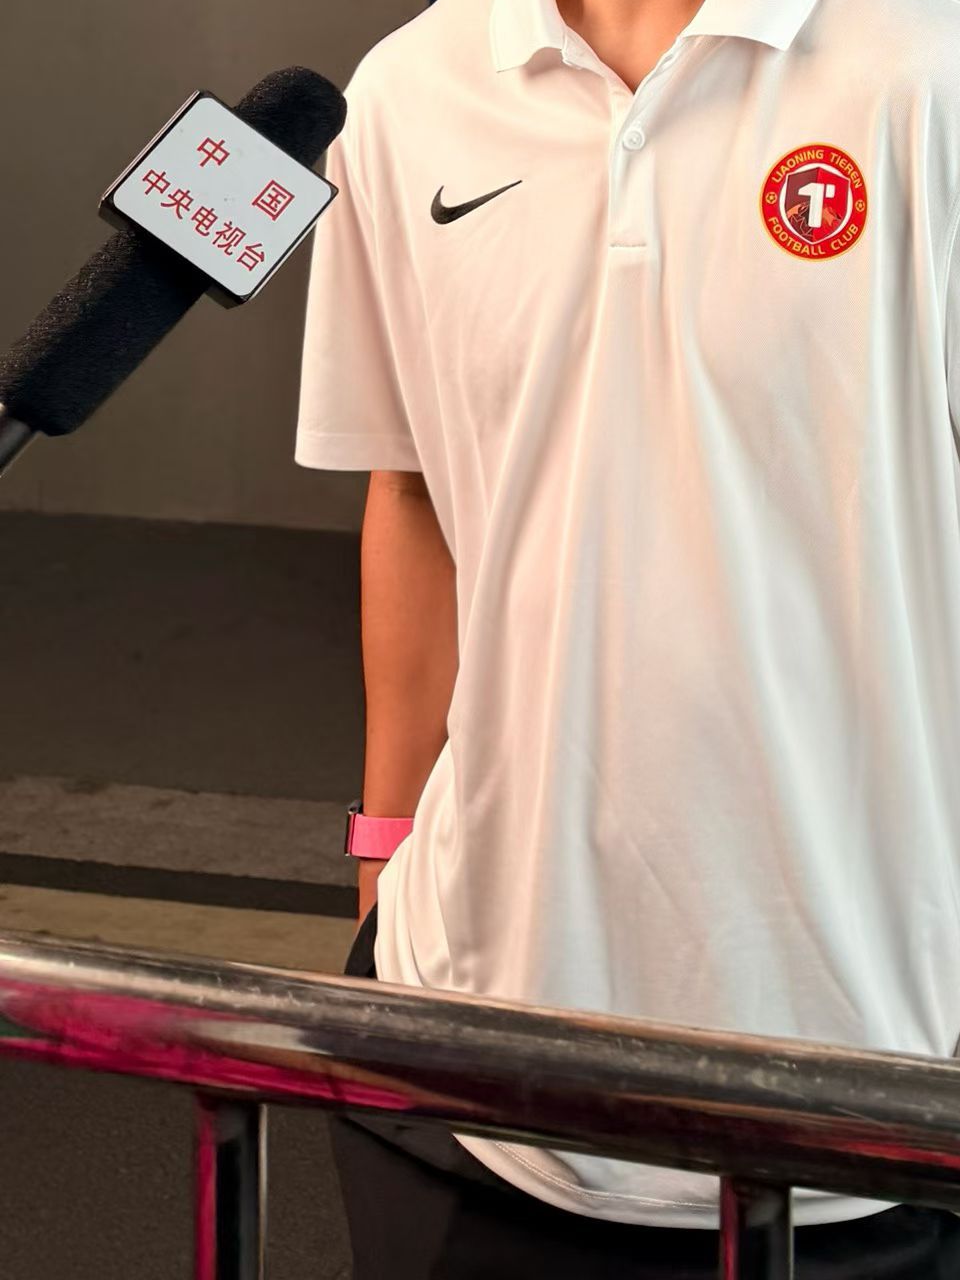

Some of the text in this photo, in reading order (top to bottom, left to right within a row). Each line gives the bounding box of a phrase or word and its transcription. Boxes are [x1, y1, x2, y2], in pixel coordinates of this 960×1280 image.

[771, 149, 863, 189] LIAONING TIEREN
[142, 168, 266, 272] 中央电视台
[768, 216, 859, 256] FOOTBALL CLUB
